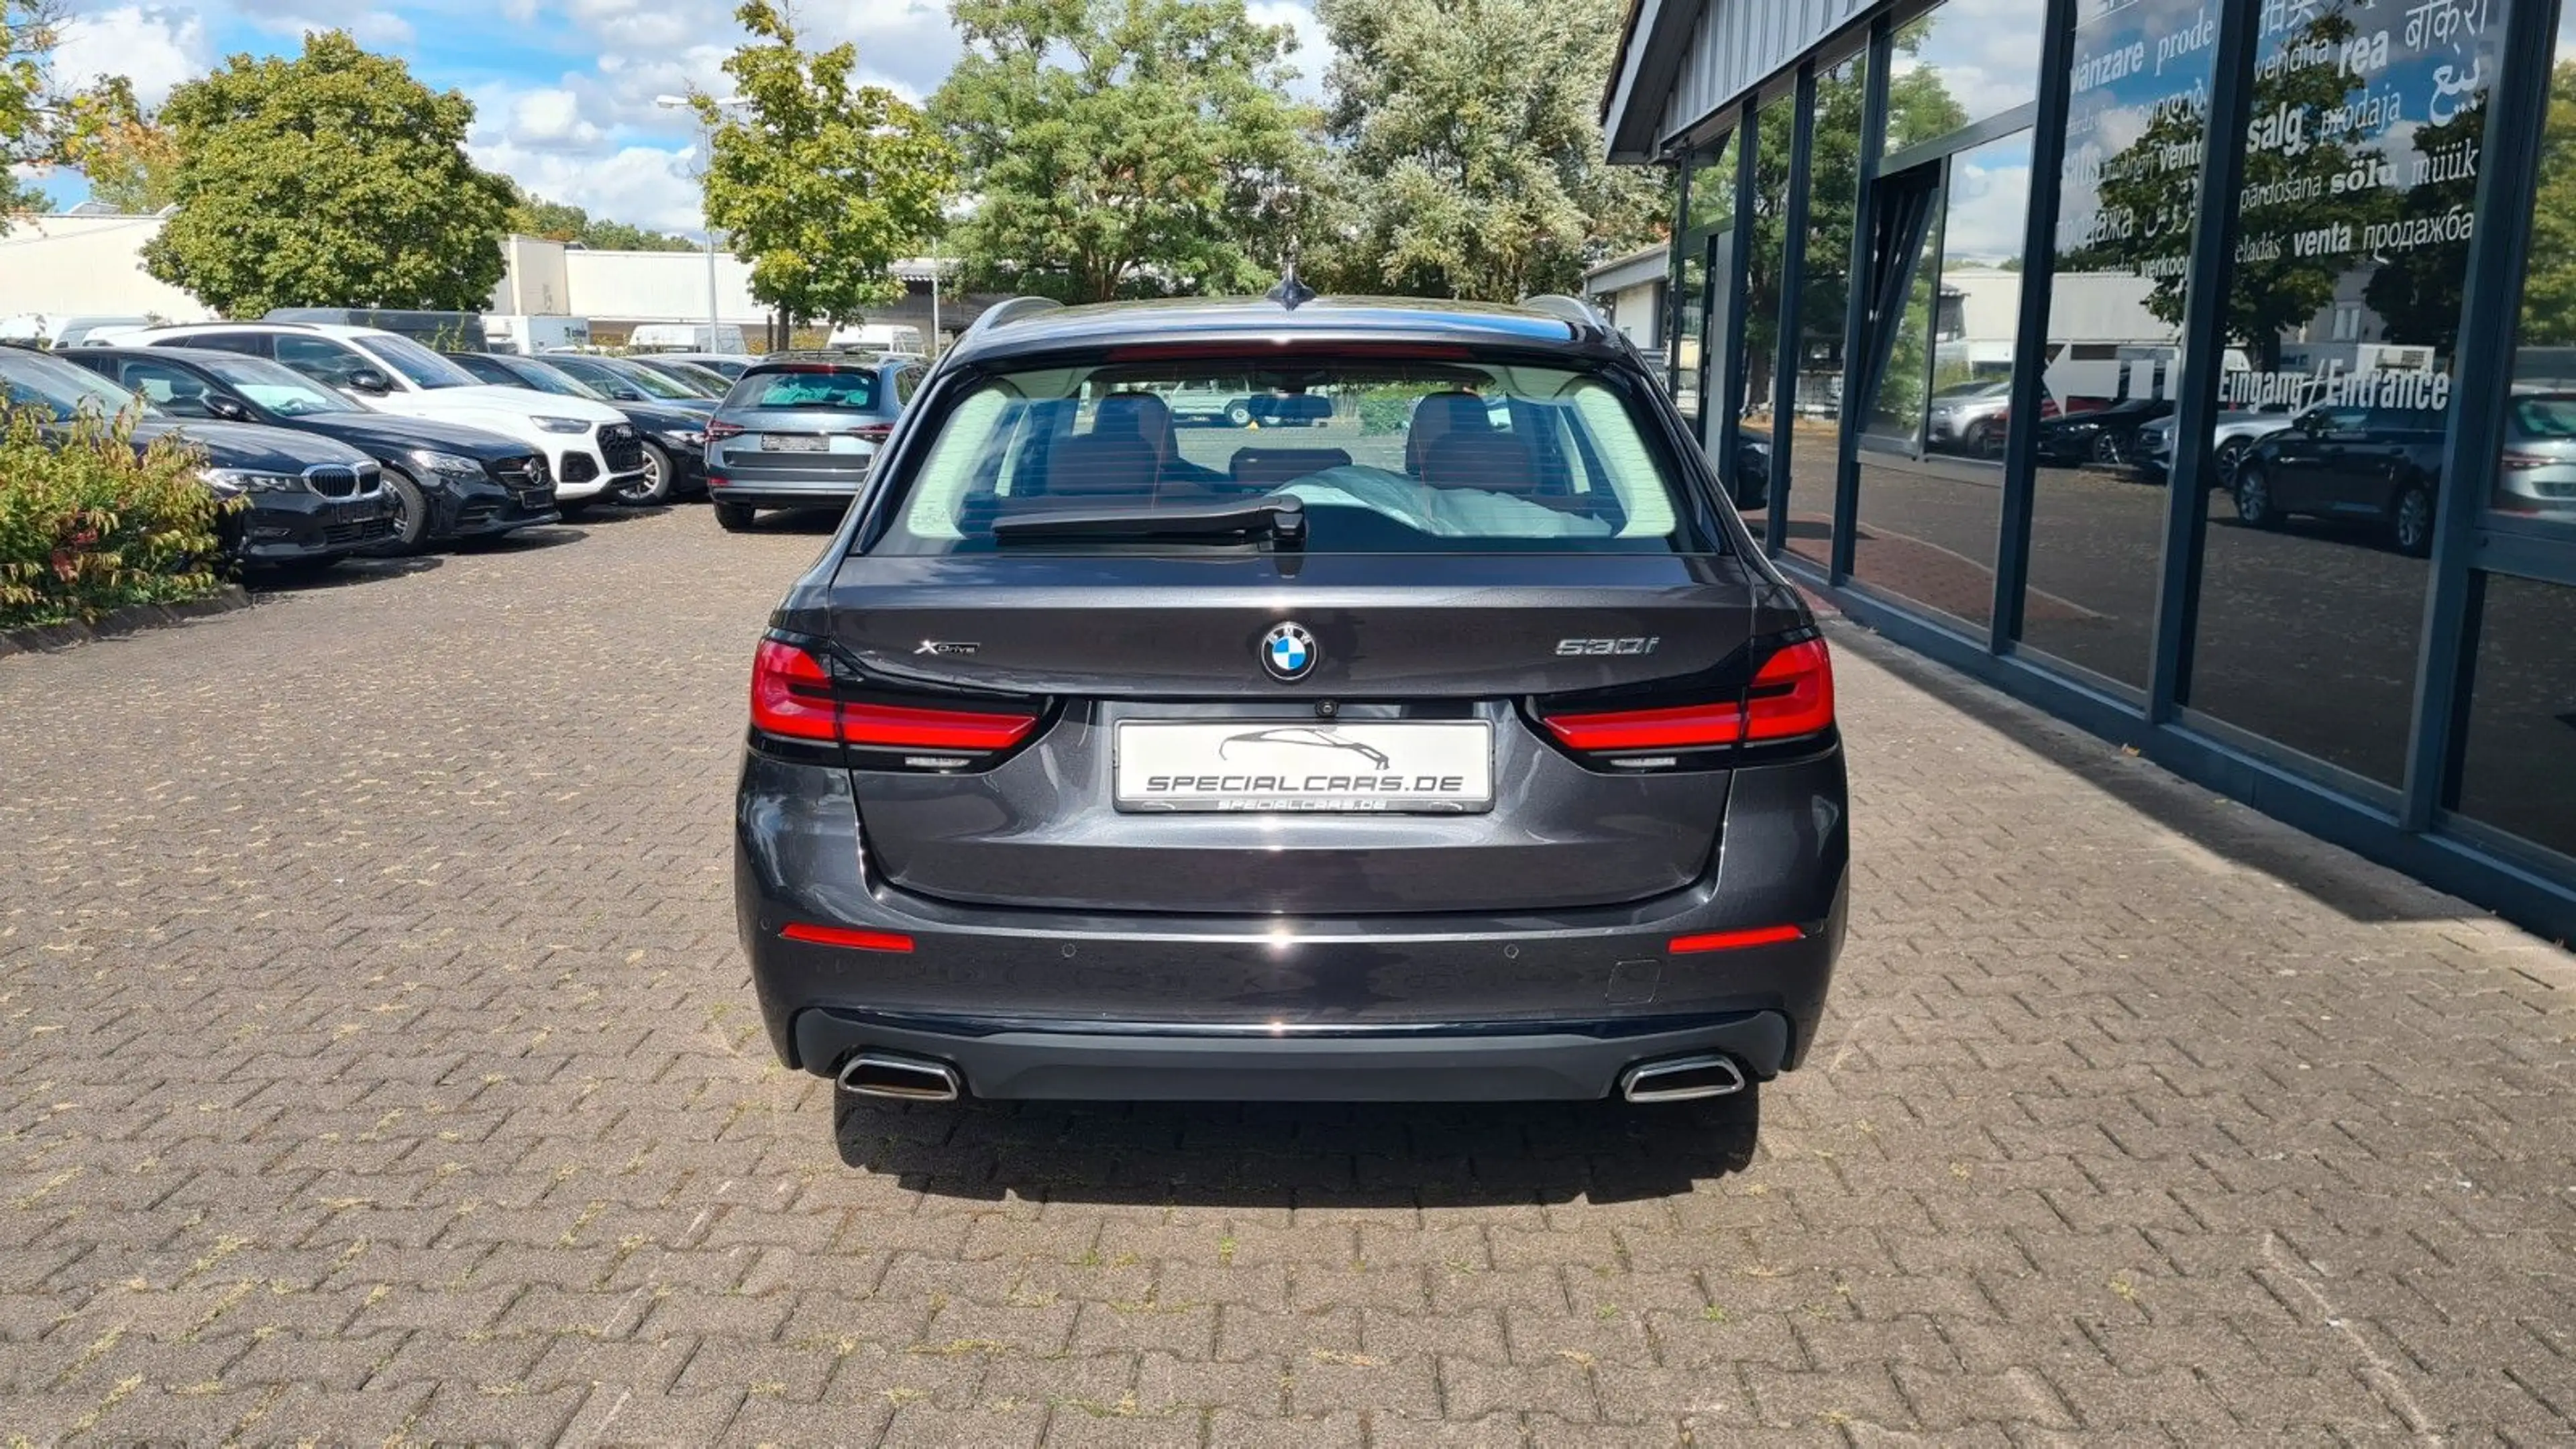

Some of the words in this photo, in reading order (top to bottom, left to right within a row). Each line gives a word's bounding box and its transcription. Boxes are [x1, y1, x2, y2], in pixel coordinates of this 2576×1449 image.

[2254, 33, 2330, 82] vendita
[2338, 30, 2389, 78] rea
[2246, 102, 2302, 156] salg
[2320, 83, 2402, 146] prodaja
[2330, 158, 2398, 194] sölu
[2412, 138, 2479, 186] müük
[2294, 221, 2351, 258] venta
[2363, 204, 2475, 257] продажба
[1146, 775, 1463, 792] SPECIALCARS.DE
